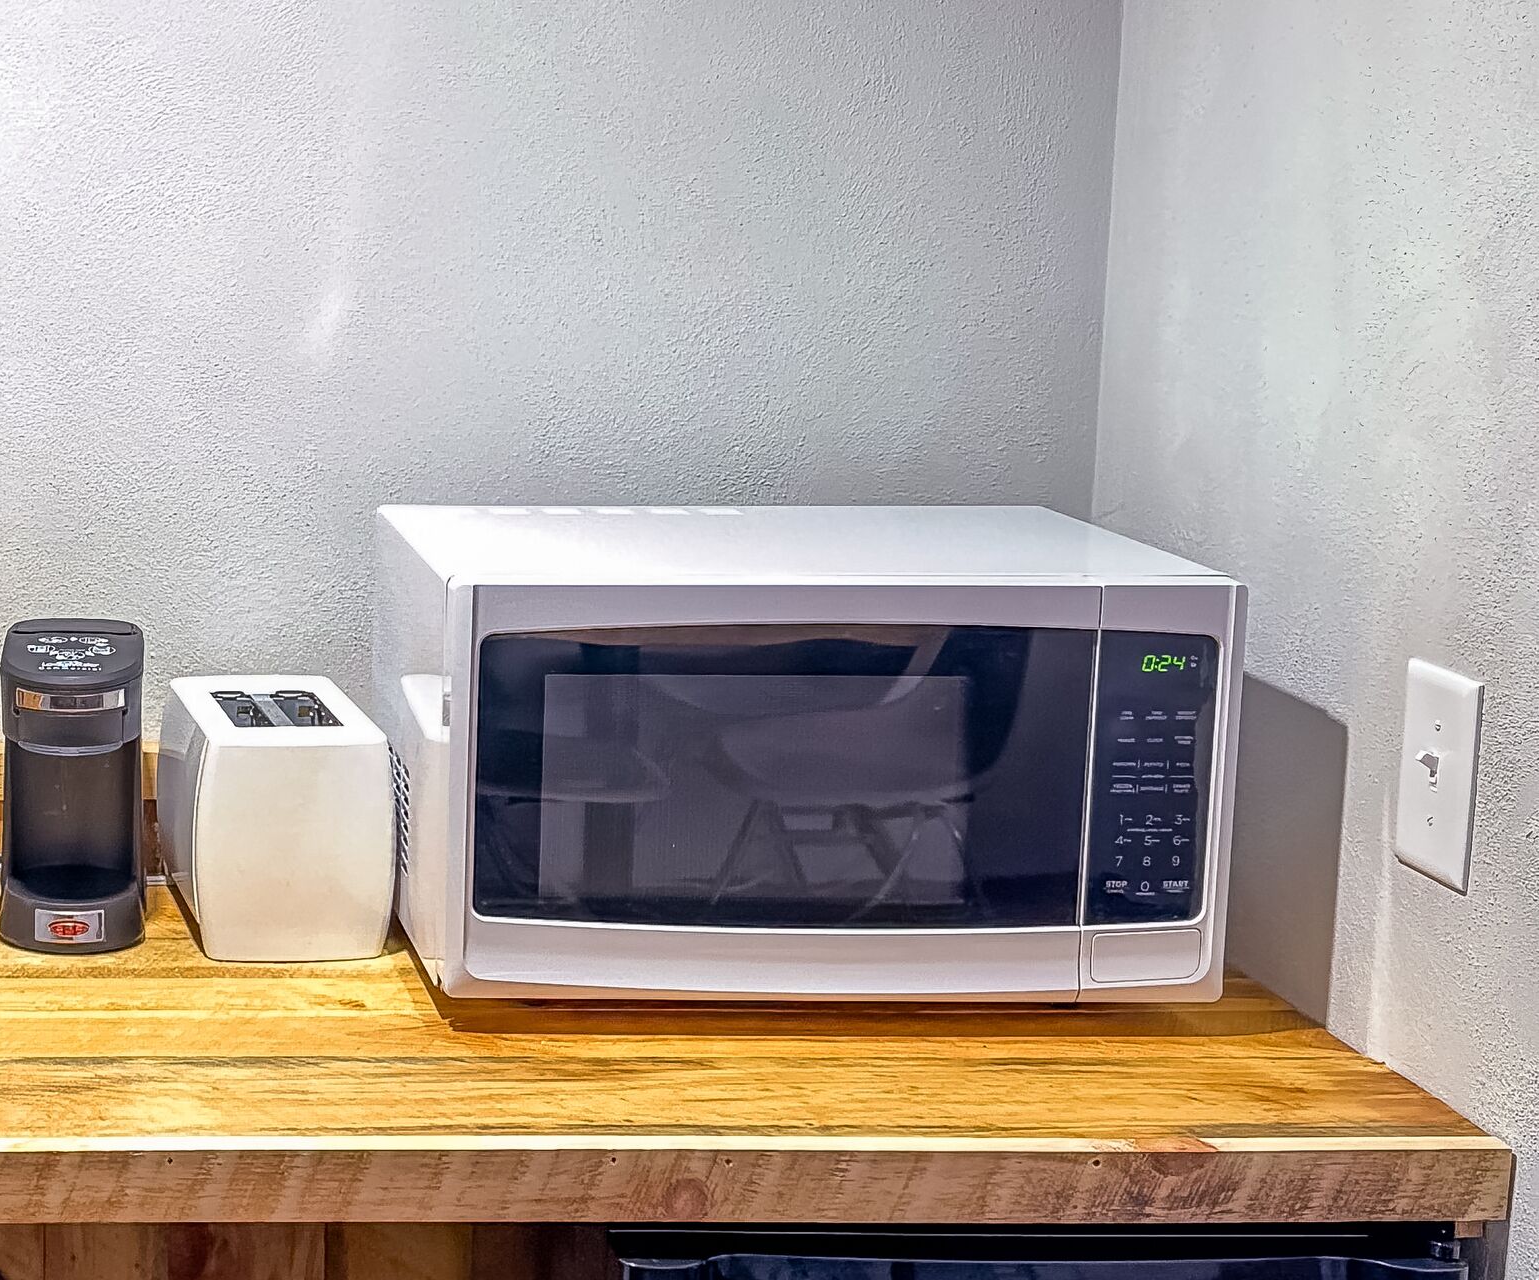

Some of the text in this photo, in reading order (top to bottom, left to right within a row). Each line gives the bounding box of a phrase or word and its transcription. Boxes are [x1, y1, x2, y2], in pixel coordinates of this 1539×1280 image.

[1142, 654, 1186, 672] 0:24
[1114, 855, 1124, 868] 7
[1142, 856, 1152, 867] 8
[1171, 855, 1181, 867] 9
[1105, 880, 1129, 888] STOP
[1162, 880, 1190, 889] START
